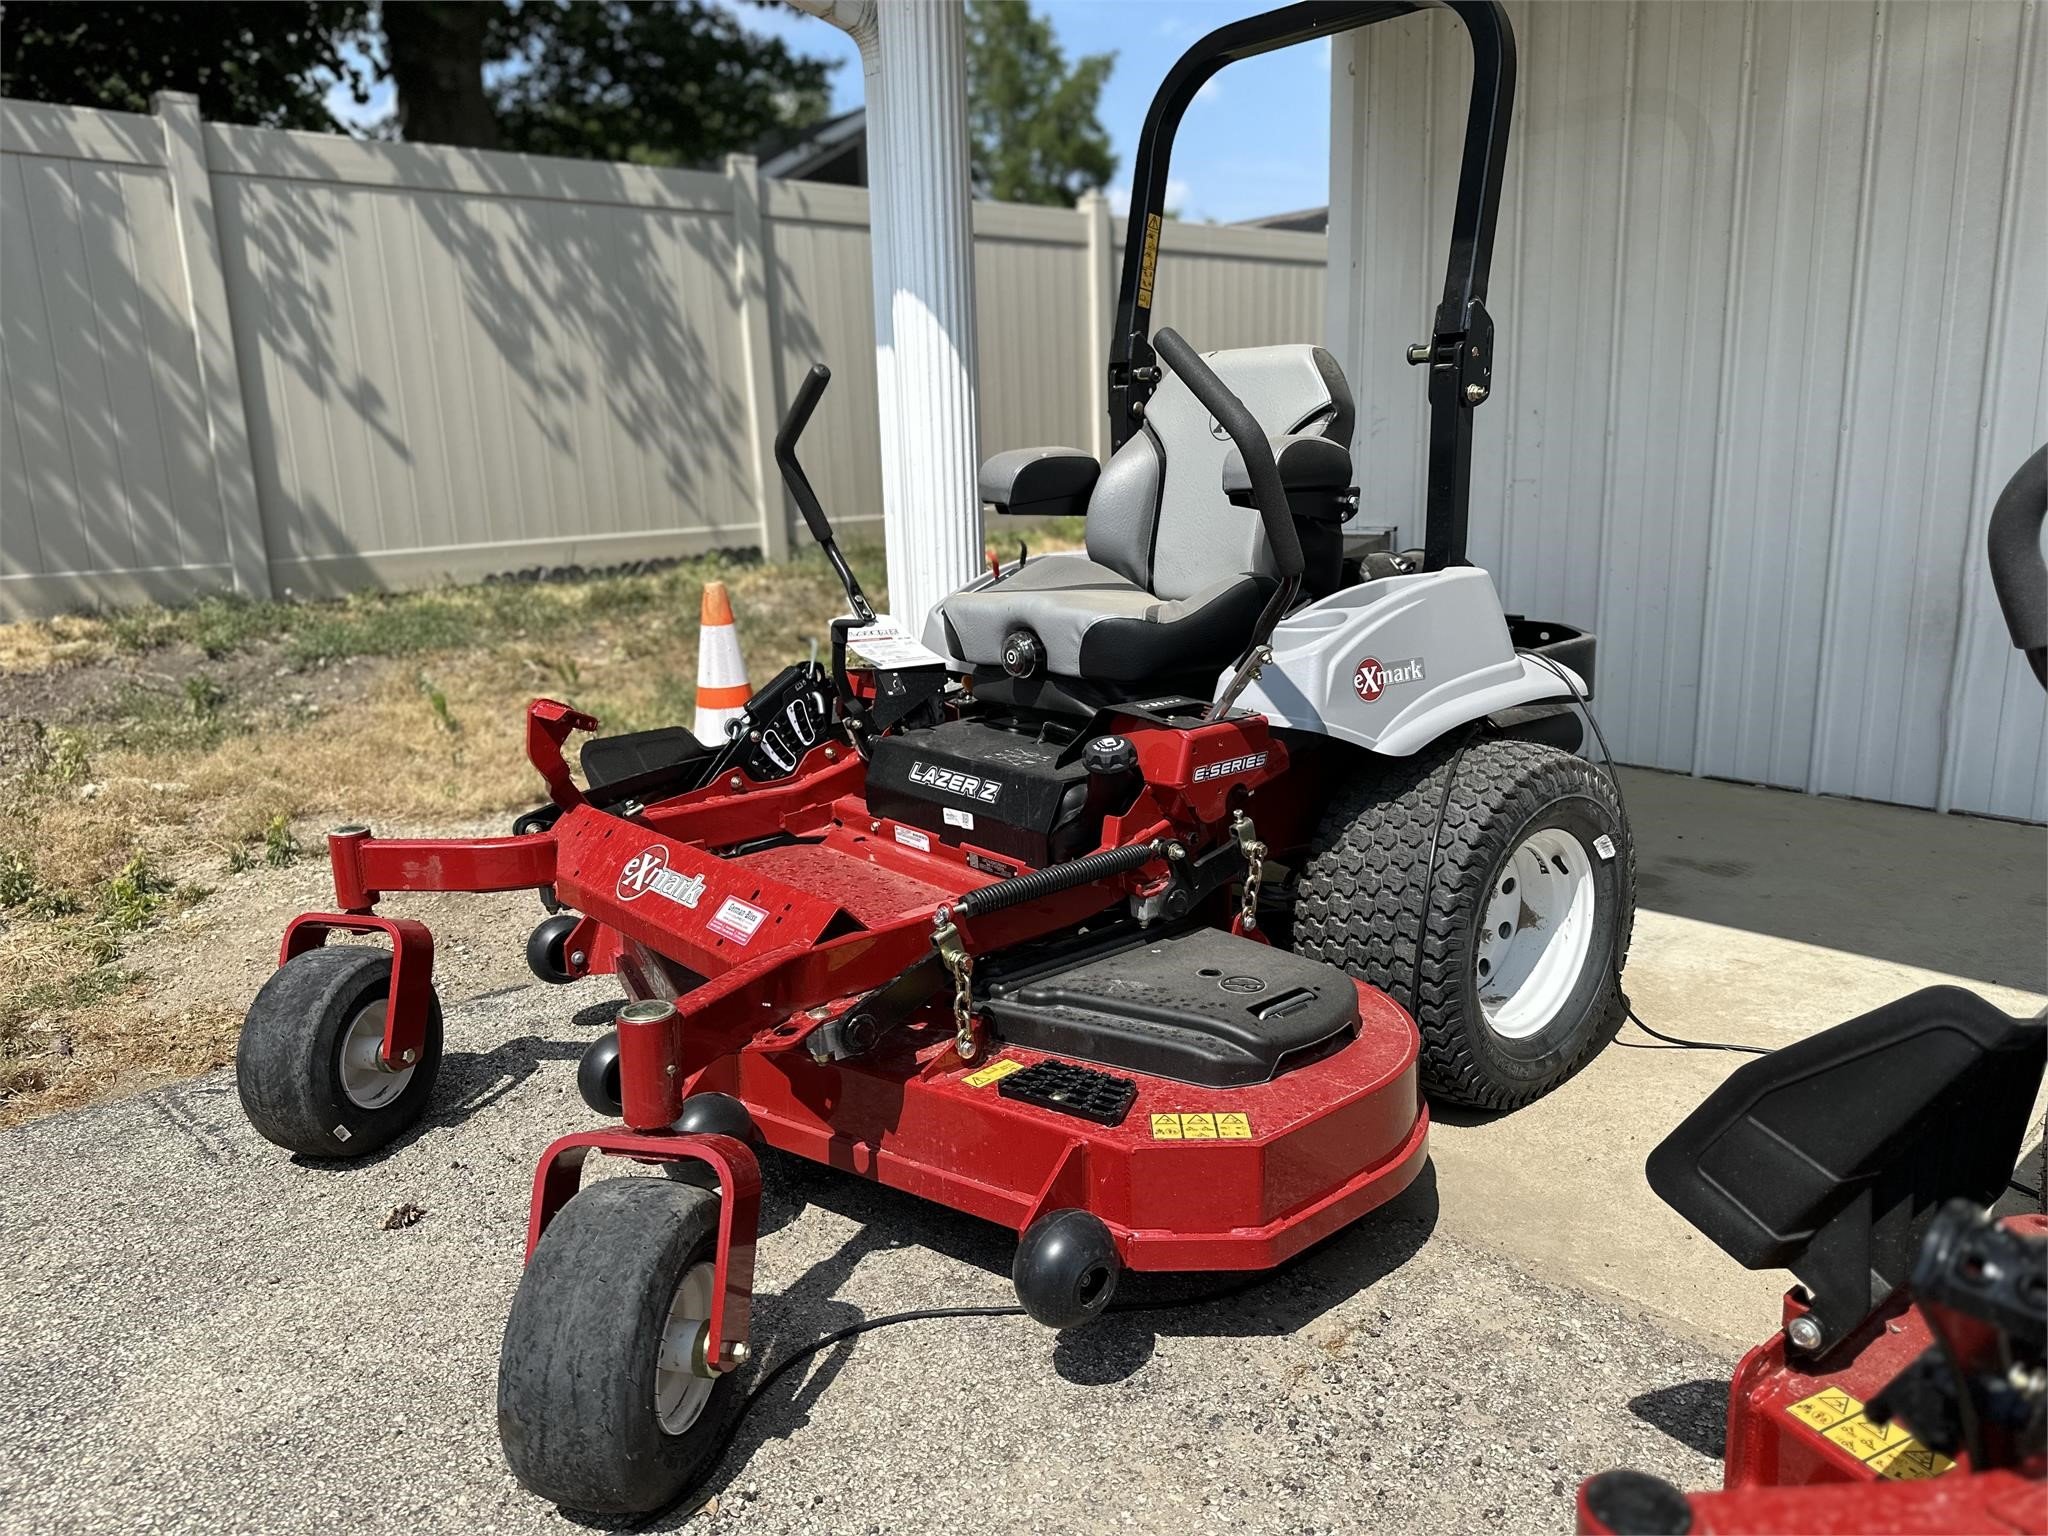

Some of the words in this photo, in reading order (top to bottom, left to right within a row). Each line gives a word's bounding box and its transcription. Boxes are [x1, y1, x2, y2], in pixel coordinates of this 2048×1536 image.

[1354, 660, 1424, 695] eXmark
[909, 762, 980, 799] LAZER
[978, 781, 1000, 802] Z
[1193, 752, 1267, 782] E-SERIES
[621, 852, 704, 905] eXmark
